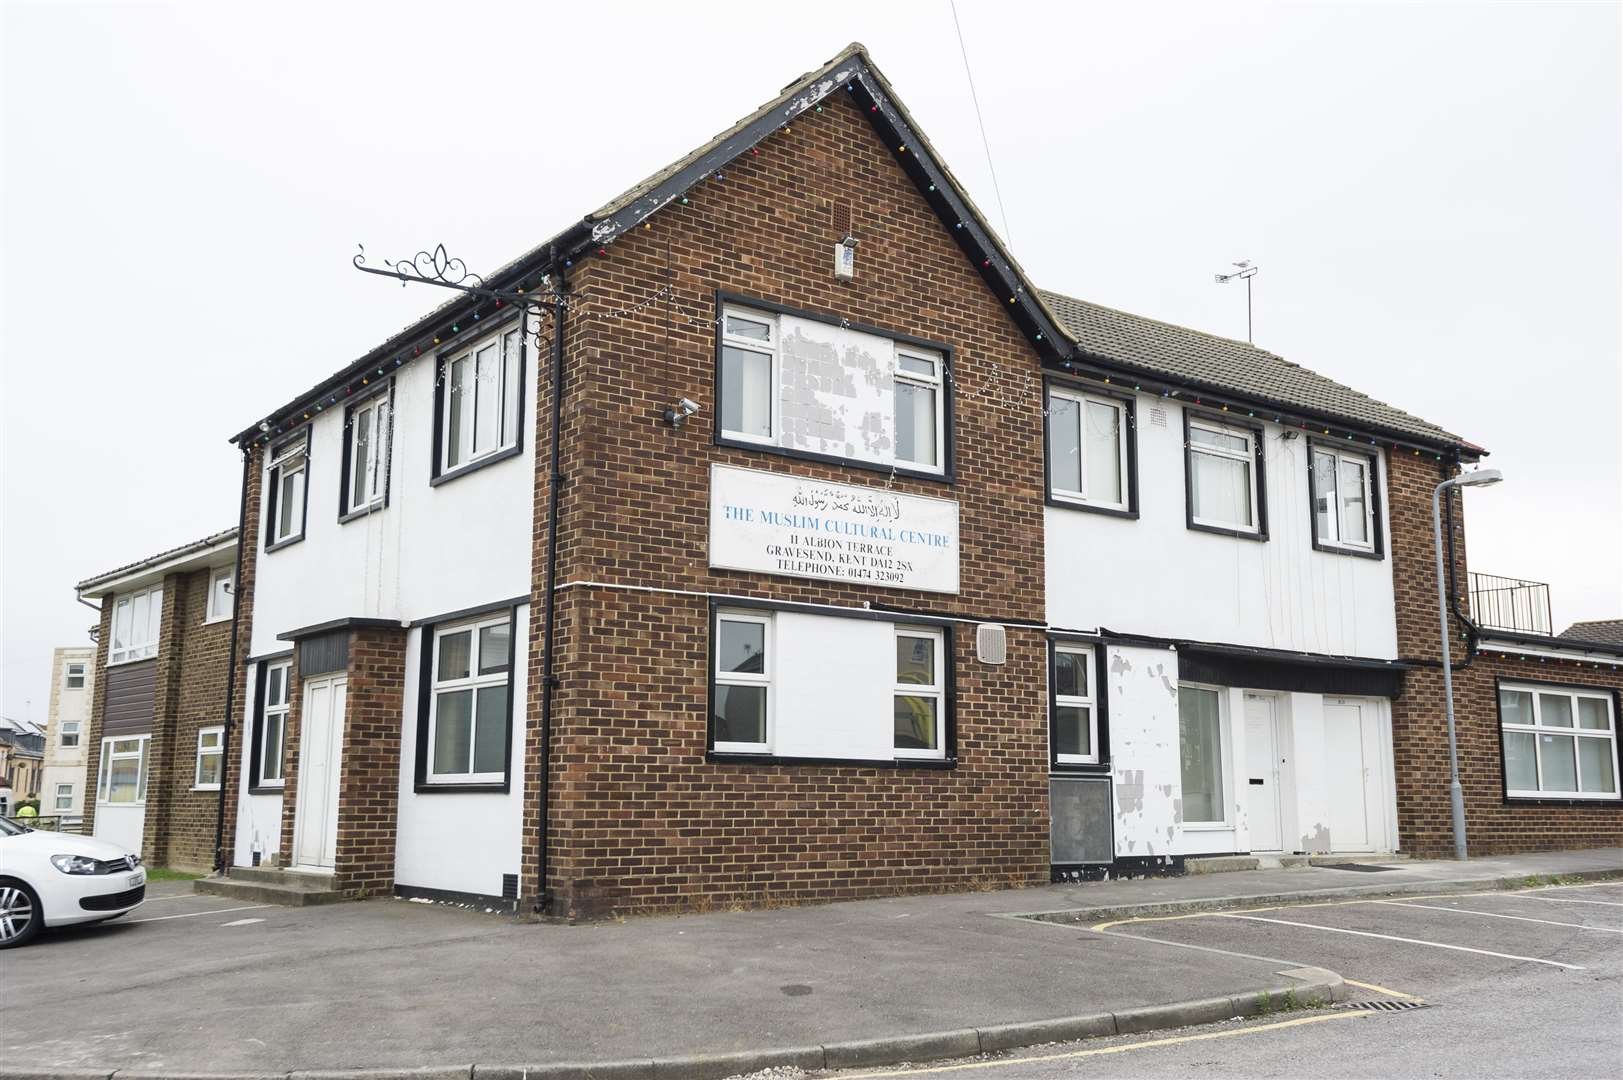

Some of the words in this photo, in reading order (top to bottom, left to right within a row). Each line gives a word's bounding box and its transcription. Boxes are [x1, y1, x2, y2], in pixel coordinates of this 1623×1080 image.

[723, 506, 754, 522] THE
[760, 510, 820, 531] MUSLIM
[824, 519, 896, 541] CULTURAL
[899, 529, 951, 548] CENTRE
[803, 536, 843, 549] ALBION
[848, 541, 893, 556] TERRACE
[777, 558, 845, 577] TELEPHONE:
[848, 567, 871, 579] 01474
[875, 570, 904, 583] 323092
[839, 553, 868, 566] KENT
[870, 557, 893, 569] DA12
[897, 560, 913, 572] 2SX
